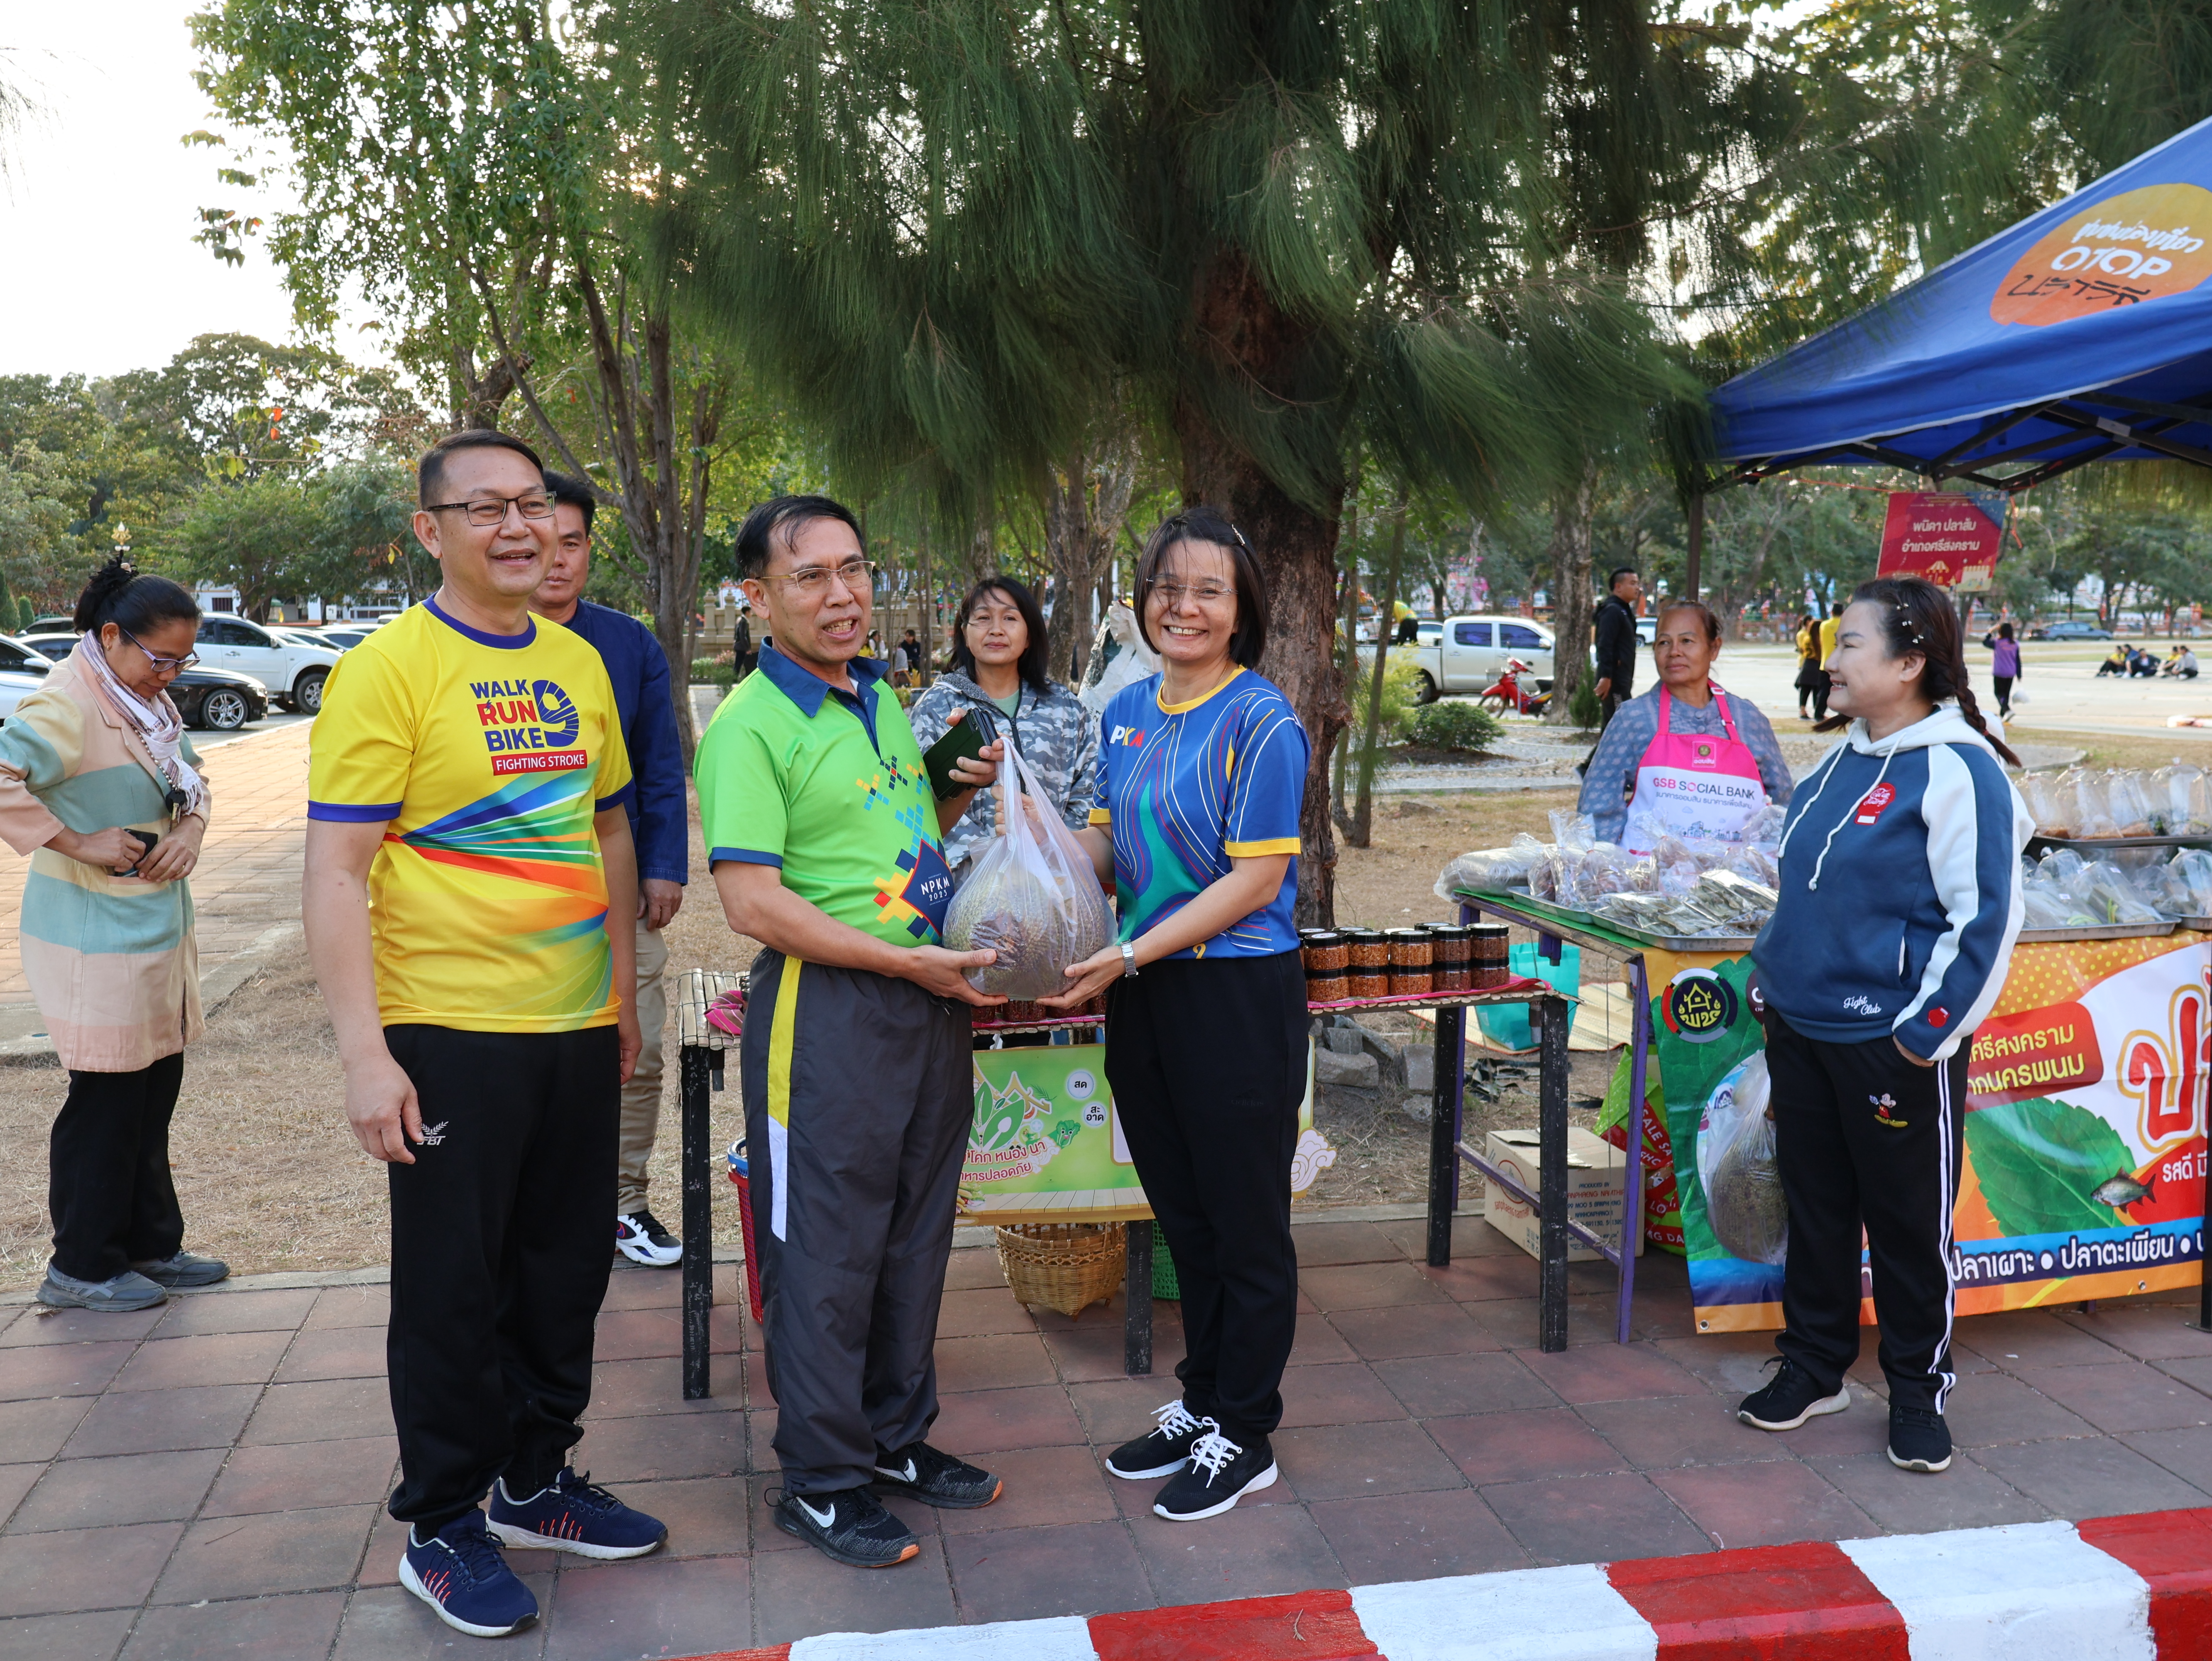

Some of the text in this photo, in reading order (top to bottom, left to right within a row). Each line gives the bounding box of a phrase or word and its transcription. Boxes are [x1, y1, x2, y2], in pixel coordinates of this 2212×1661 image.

[2051, 246, 2172, 279] OTOP
[1902, 538, 1980, 552] อำเภอศรีสงคราม
[470, 679, 531, 699] WALK
[476, 700, 538, 726] RUN
[484, 728, 545, 752] BIKE
[1110, 725, 1146, 748] PKM
[496, 754, 585, 772] FIGHTING STROKE
[1653, 777, 1755, 800] GSB SOCIAL BANK
[920, 875, 950, 895] NPKM
[929, 889, 947, 902] 2023
[1843, 995, 1868, 1009] Fight
[1860, 1003, 1882, 1015] Club
[1969, 1024, 2075, 1063] ศรีสงคราม
[971, 1150, 992, 1163] โคก
[995, 1147, 1027, 1162] หนอง
[1029, 1141, 1046, 1154] นา
[2162, 1152, 2193, 1183] รสดี
[2061, 1231, 2174, 1269] ปลาตะเพียน
